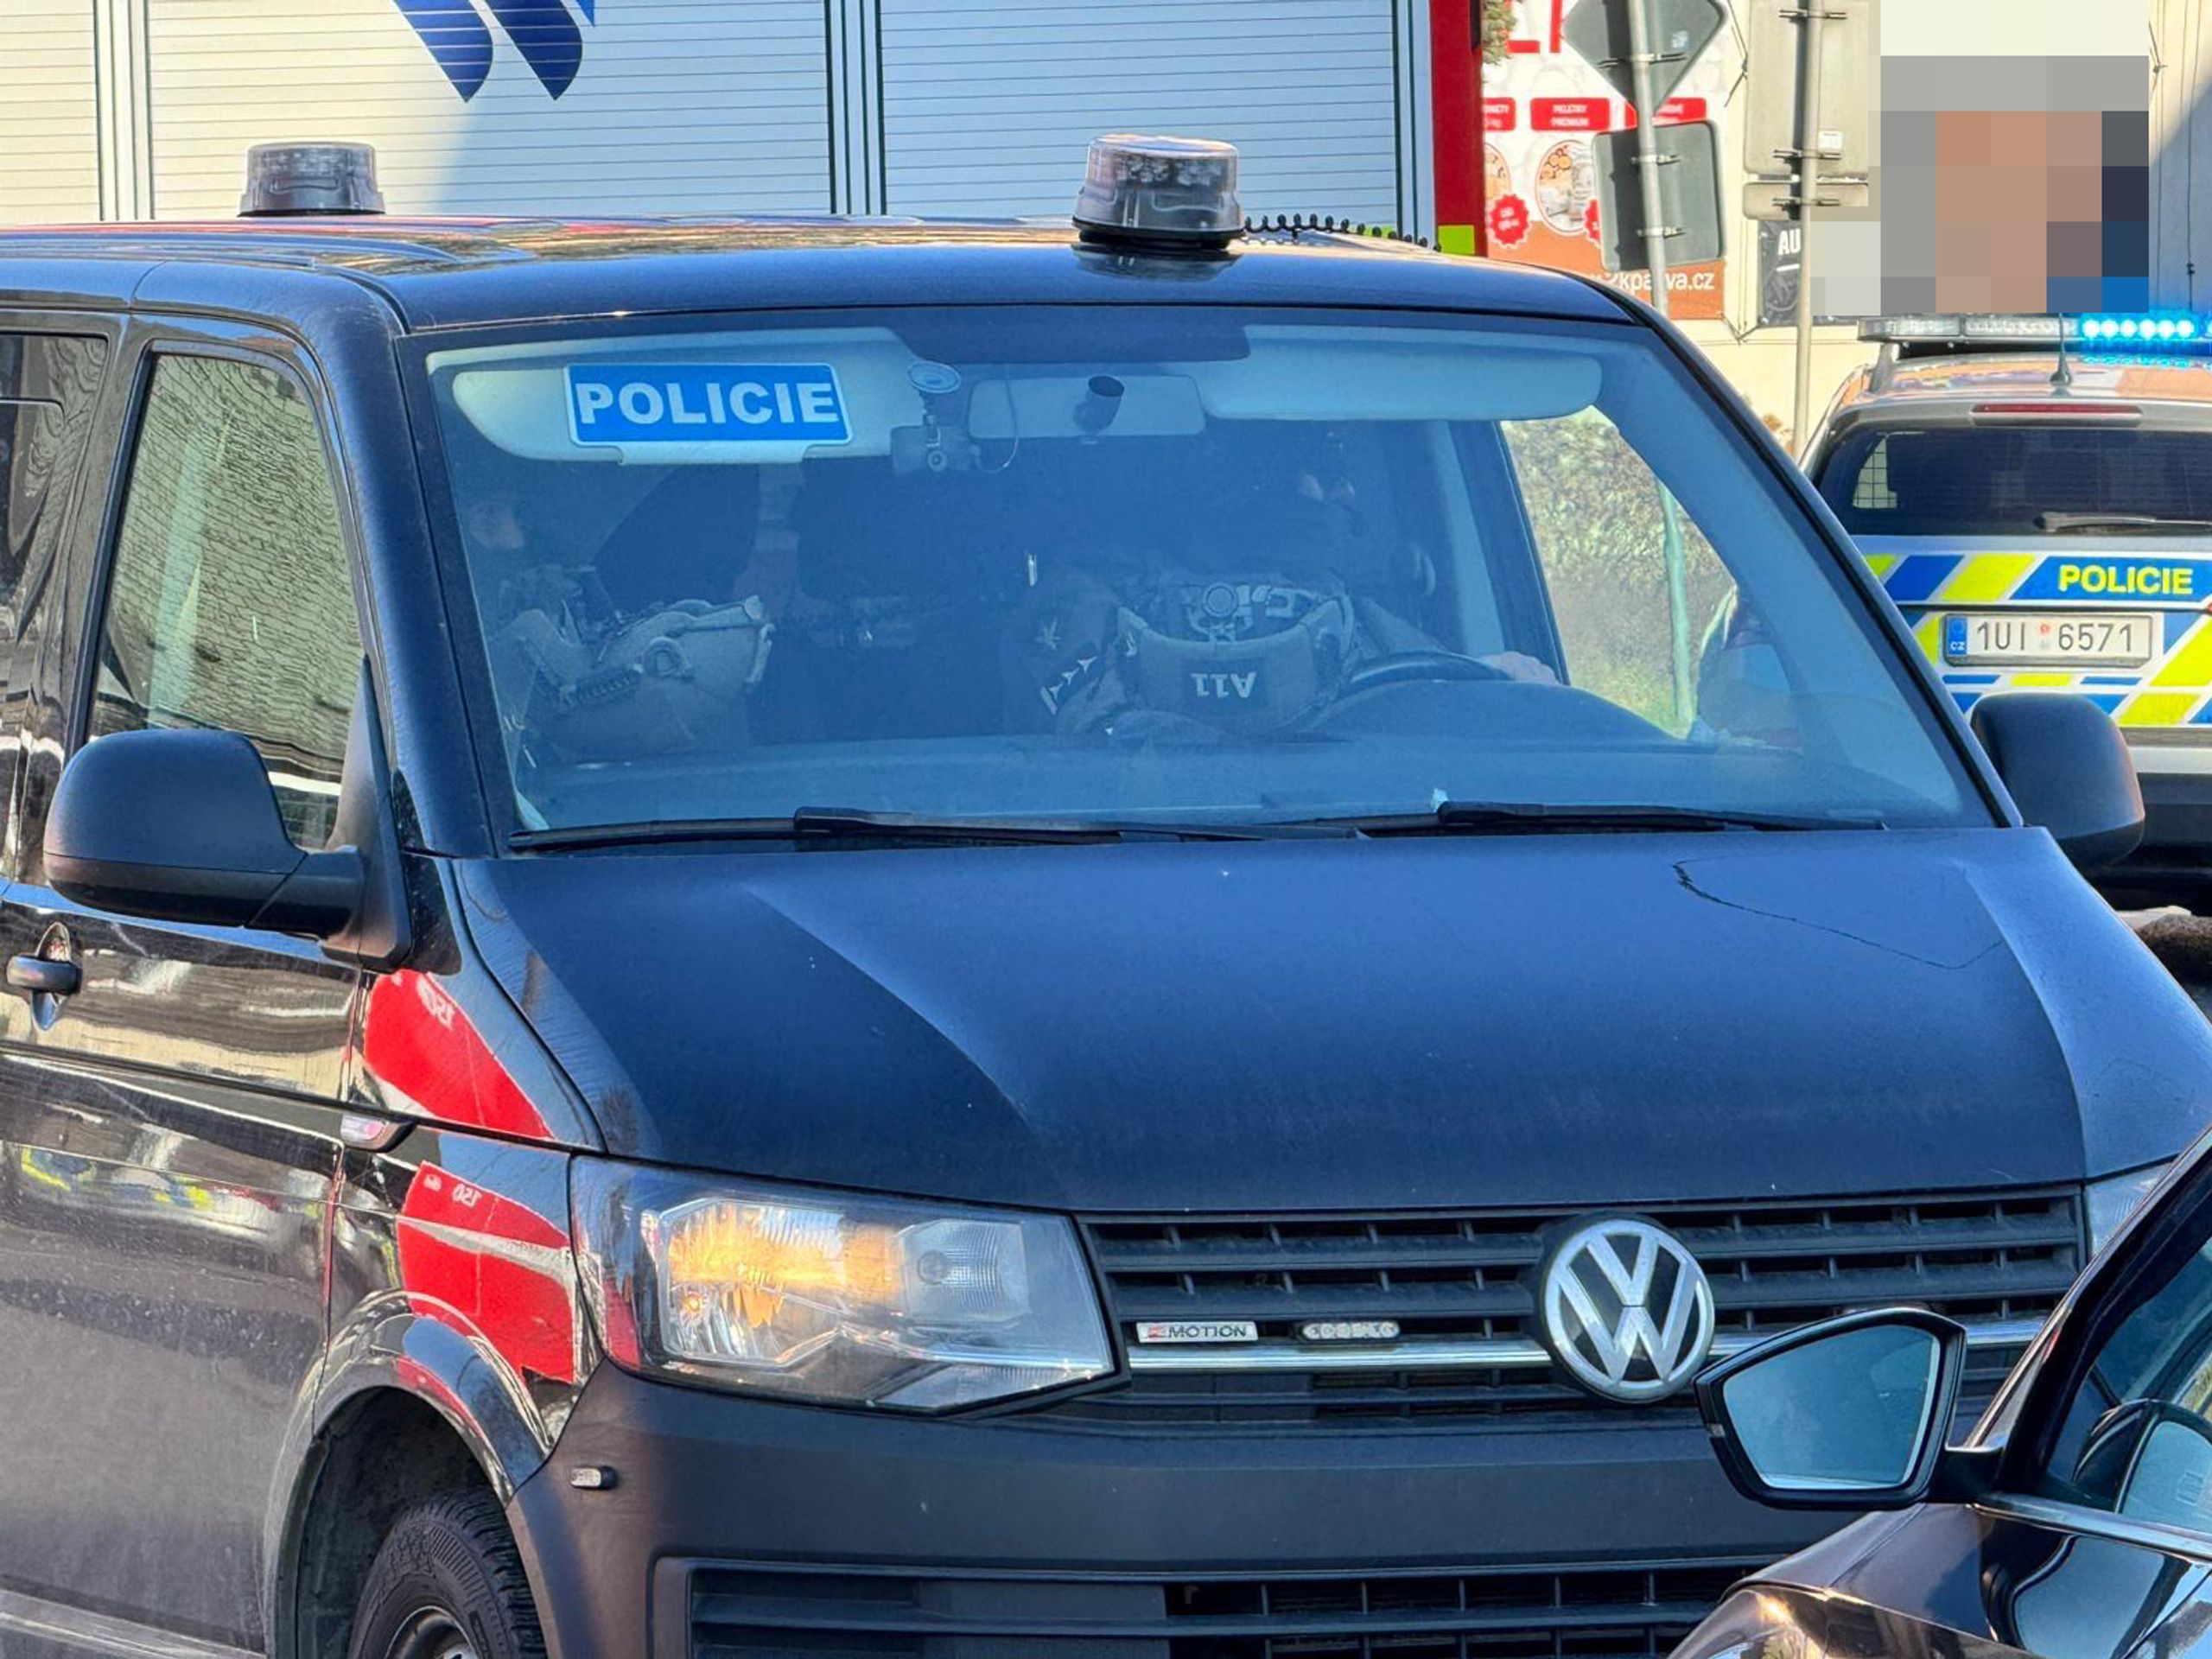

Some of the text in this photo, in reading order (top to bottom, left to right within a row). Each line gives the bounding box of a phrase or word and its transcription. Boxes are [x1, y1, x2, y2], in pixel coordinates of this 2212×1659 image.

[1777, 228, 1801, 255] AU
[575, 382, 839, 424] POLICIE
[2058, 565, 2193, 594] POLICIE
[1950, 642, 1965, 651] CZ
[1977, 621, 2133, 652] 1UI 6571
[1191, 672, 1256, 698] A11
